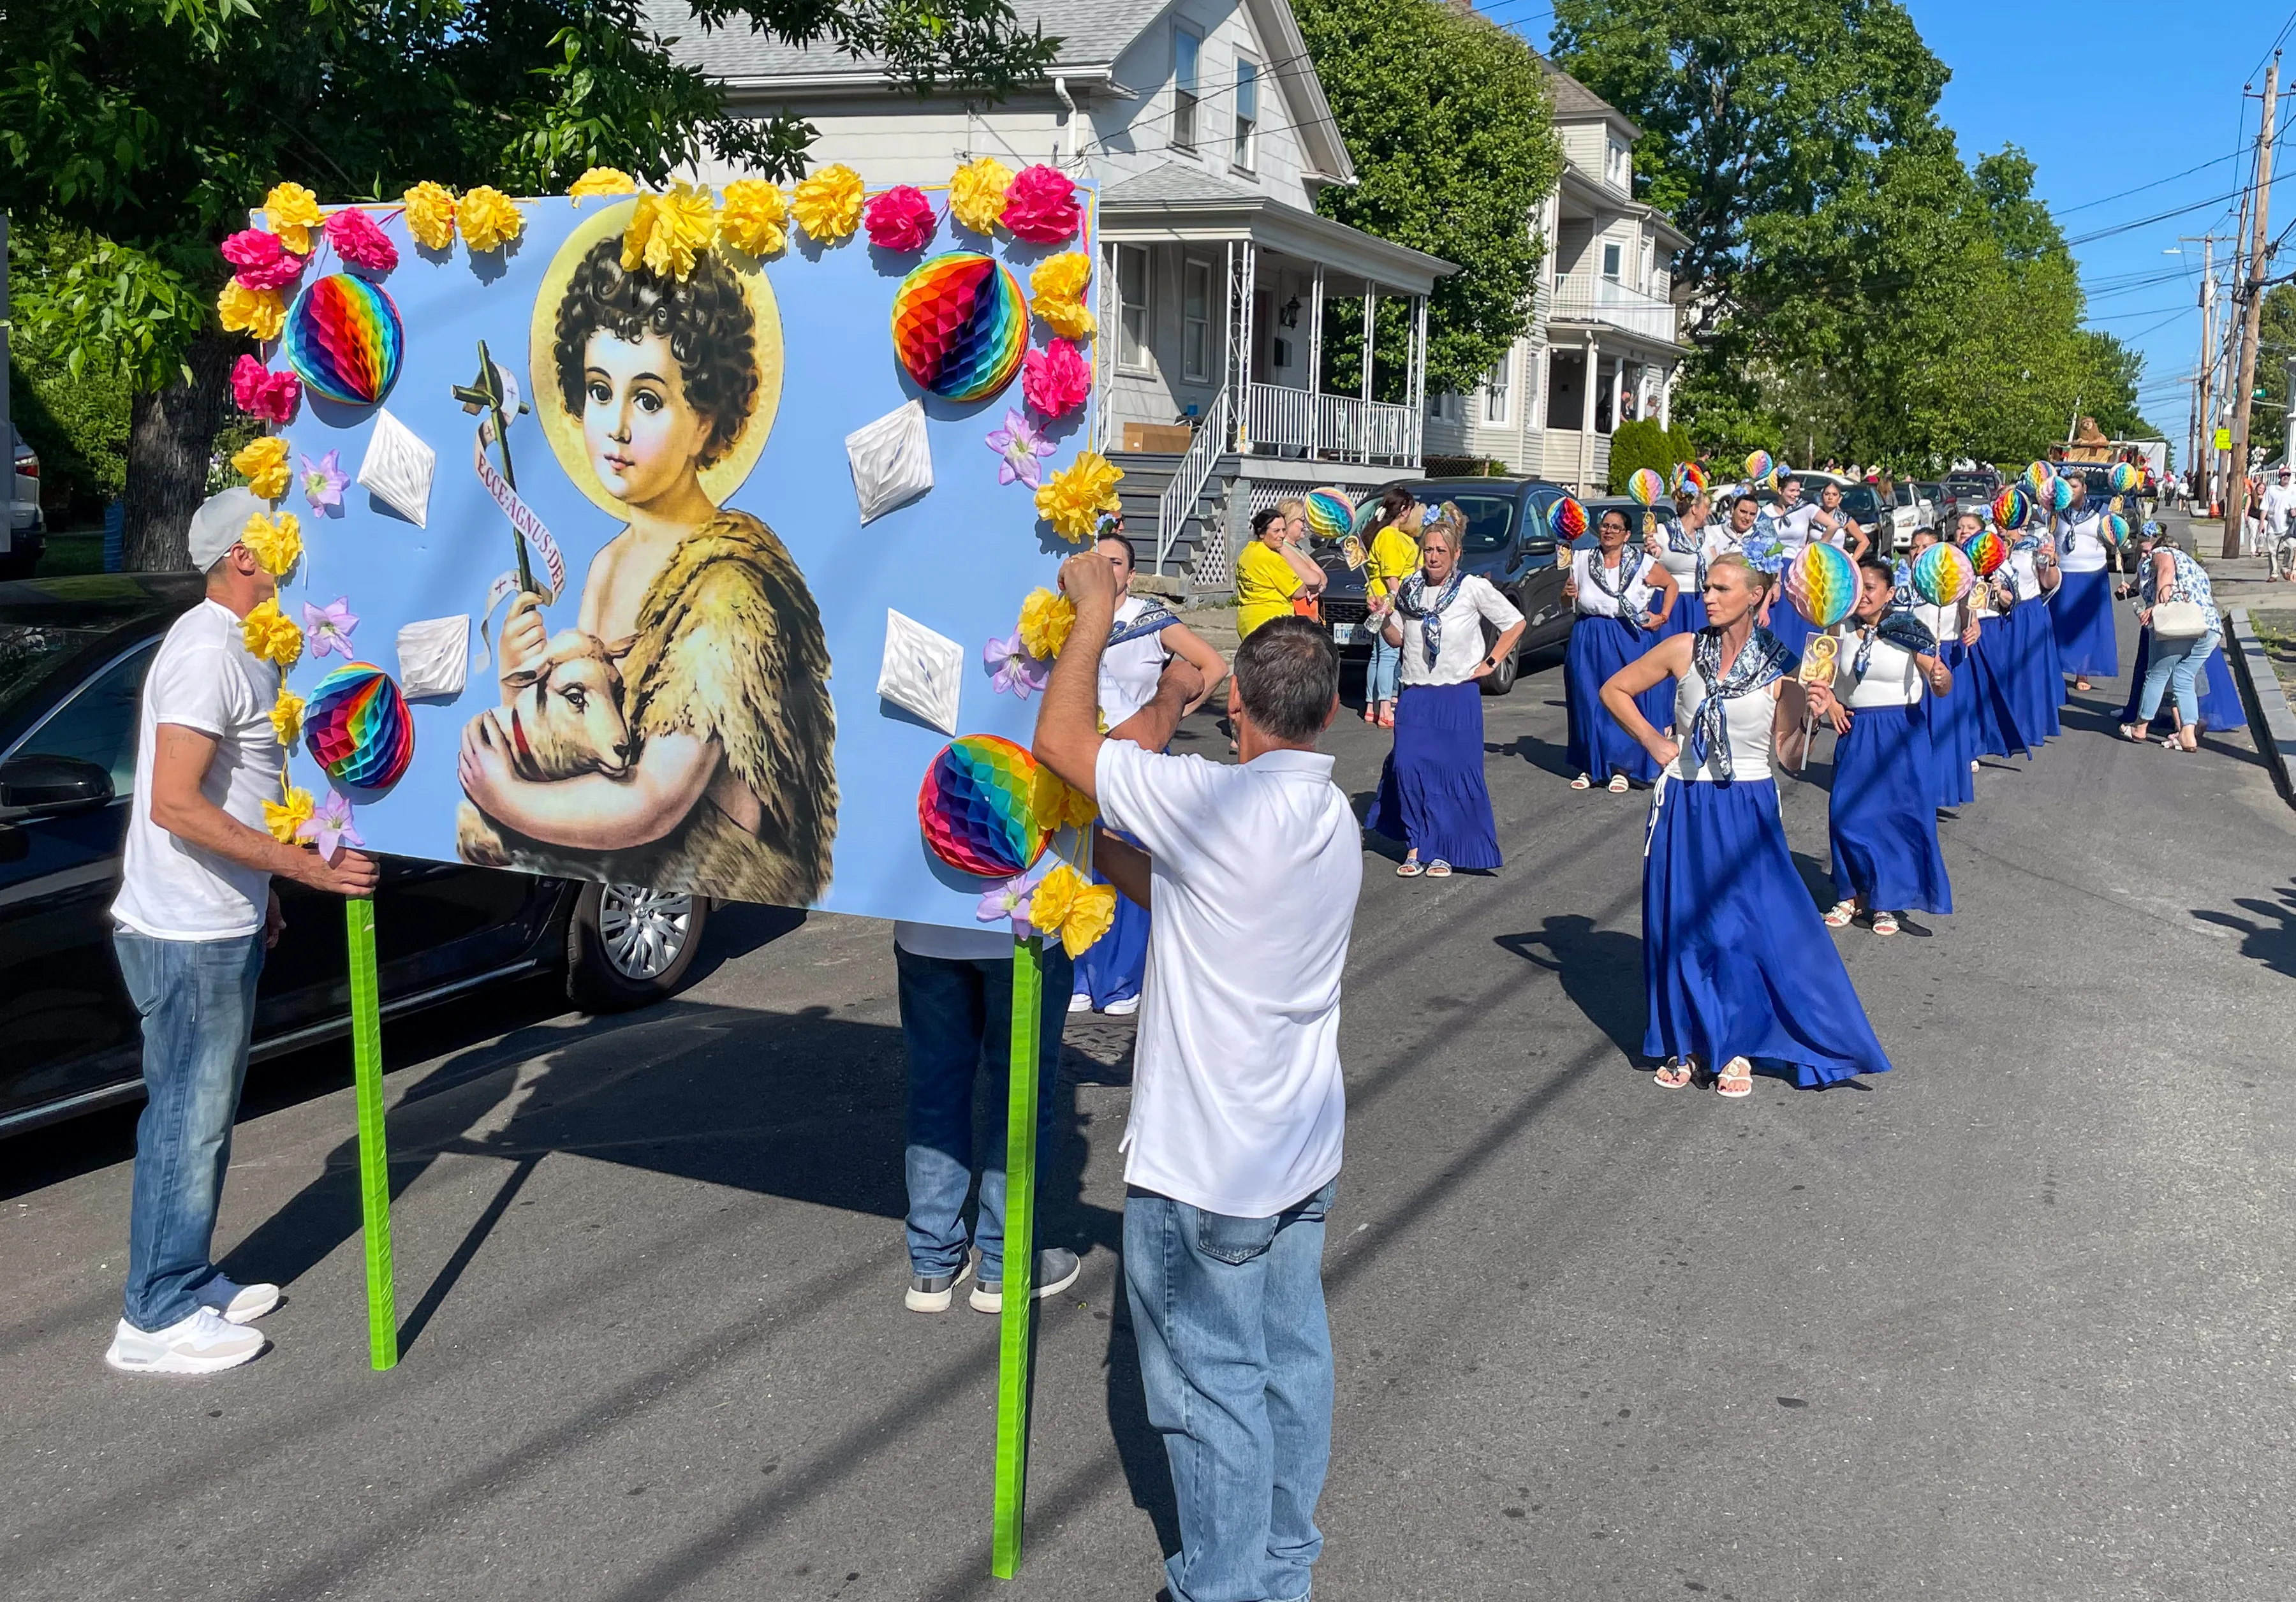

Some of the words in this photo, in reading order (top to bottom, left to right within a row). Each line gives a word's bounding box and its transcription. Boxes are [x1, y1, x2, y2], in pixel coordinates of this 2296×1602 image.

[478, 452, 508, 506] ECCE
[506, 496, 552, 553] AGNUS
[547, 548, 564, 593] DEI
